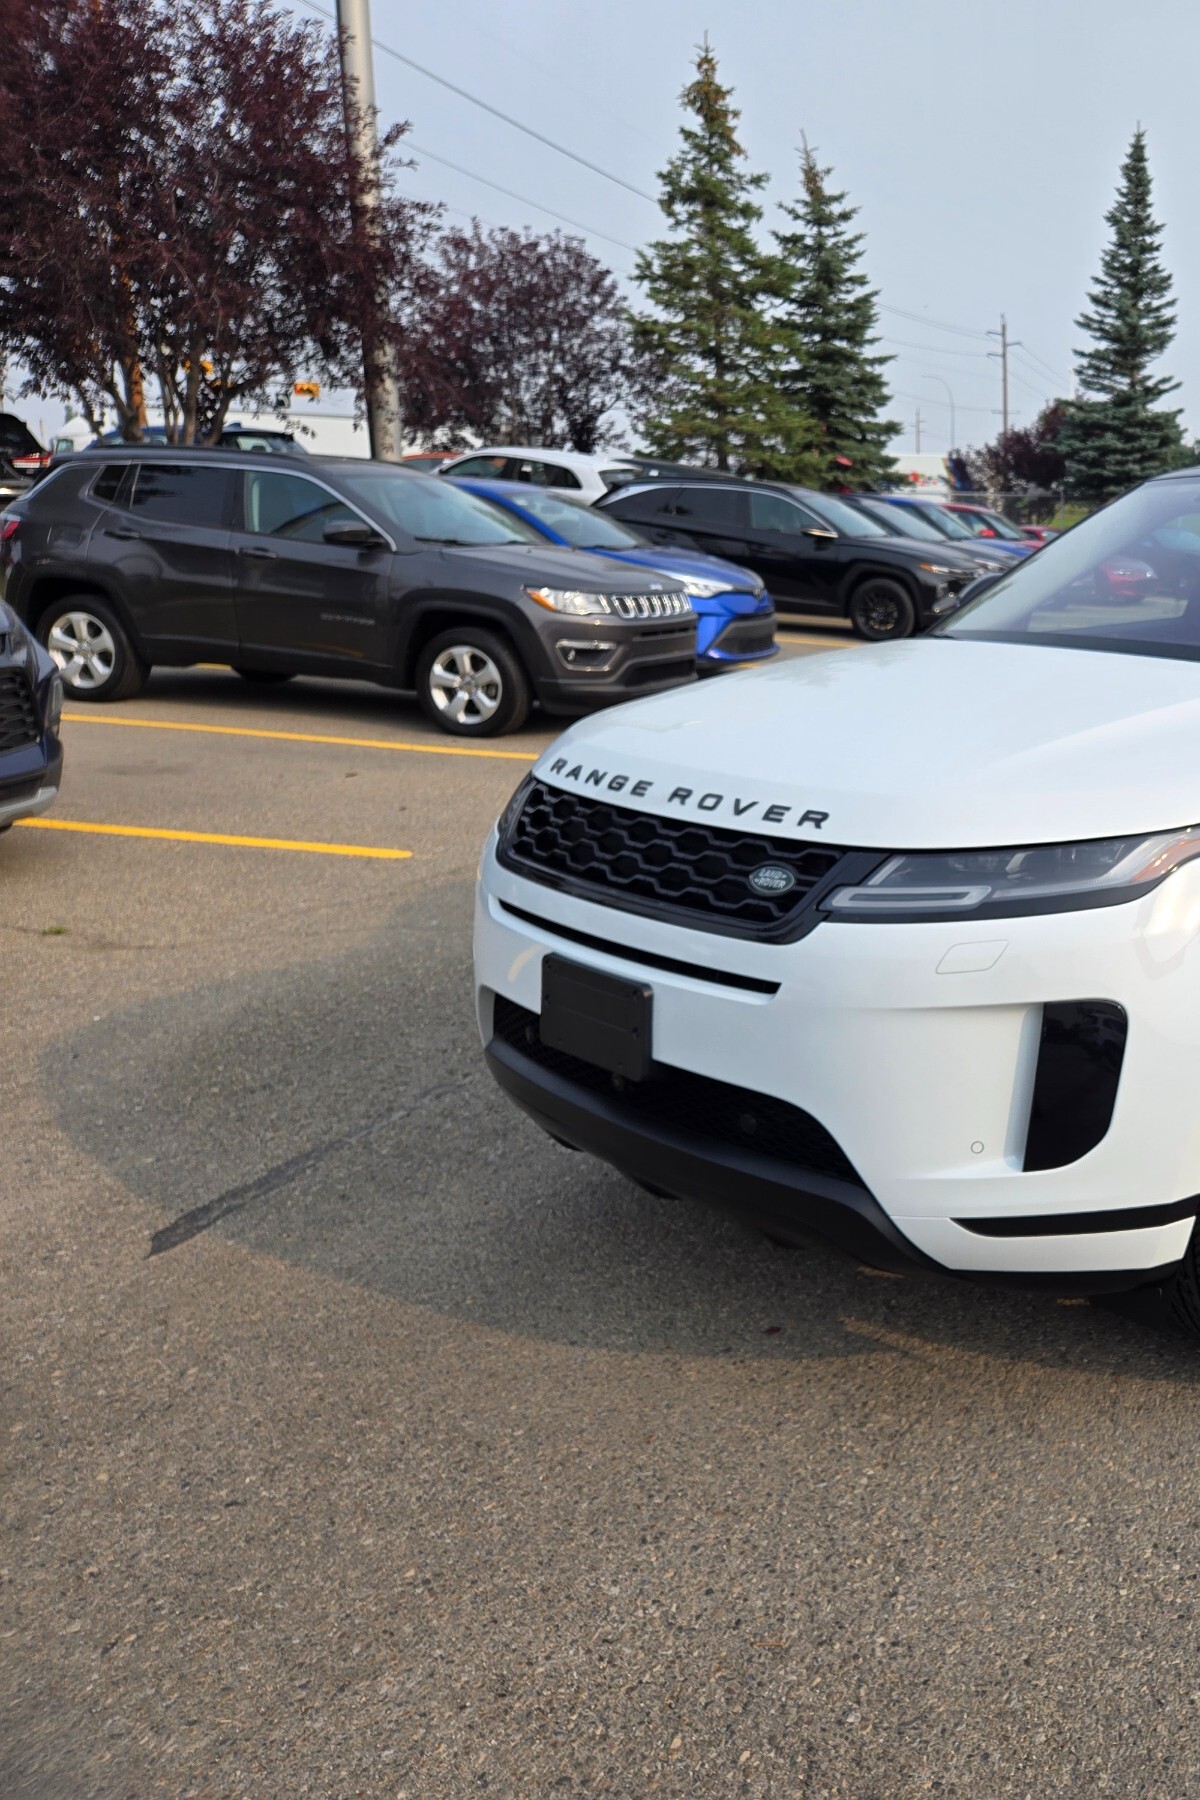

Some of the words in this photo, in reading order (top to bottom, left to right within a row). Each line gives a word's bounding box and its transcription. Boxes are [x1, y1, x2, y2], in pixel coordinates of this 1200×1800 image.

[550, 757, 654, 798] RANGE
[667, 786, 830, 830] ROVER
[758, 868, 783, 879] LAND
[757, 877, 787, 889] ROVER
